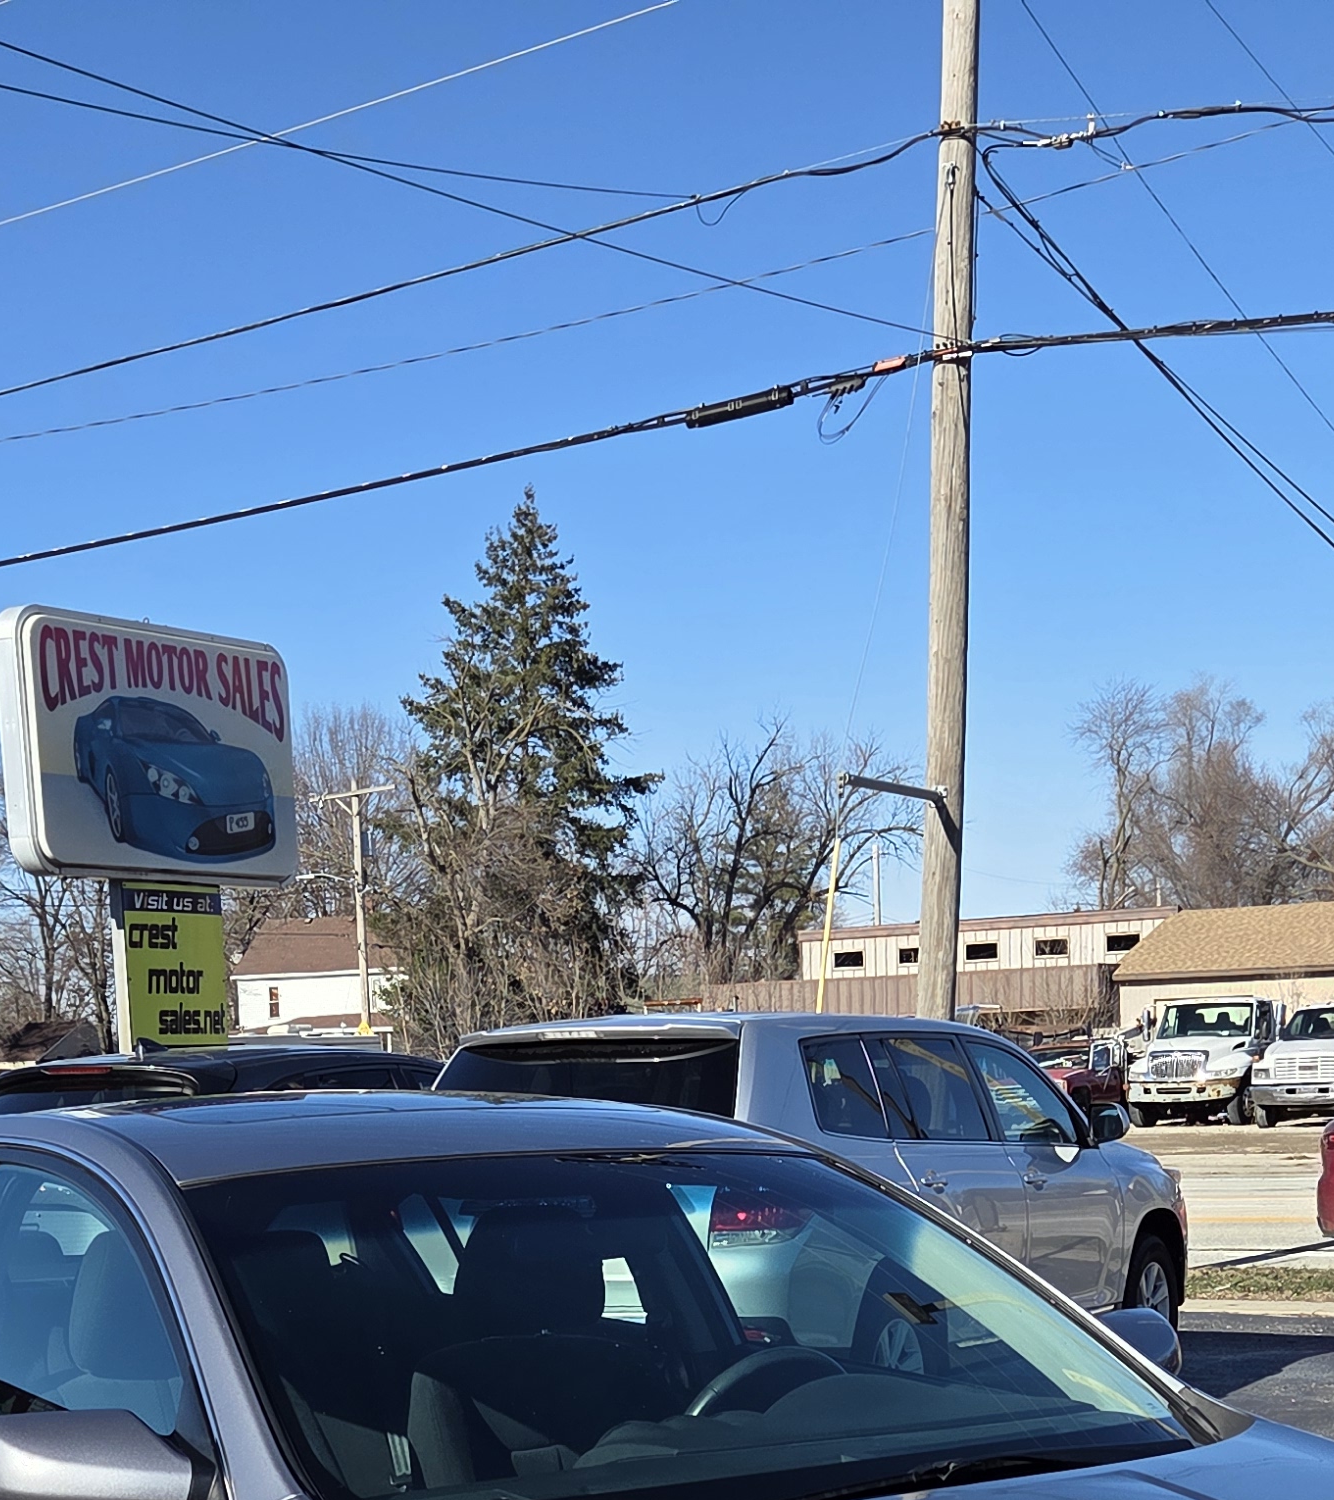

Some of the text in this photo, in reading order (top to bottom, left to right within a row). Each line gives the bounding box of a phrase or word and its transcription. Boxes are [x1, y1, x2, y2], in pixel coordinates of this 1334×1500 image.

[39, 624, 285, 743] CREST MOTOR SALES
[134, 891, 214, 912] Visit us at:
[128, 916, 178, 950] crest
[148, 961, 203, 995] motor
[158, 1001, 225, 1035] sales.net
